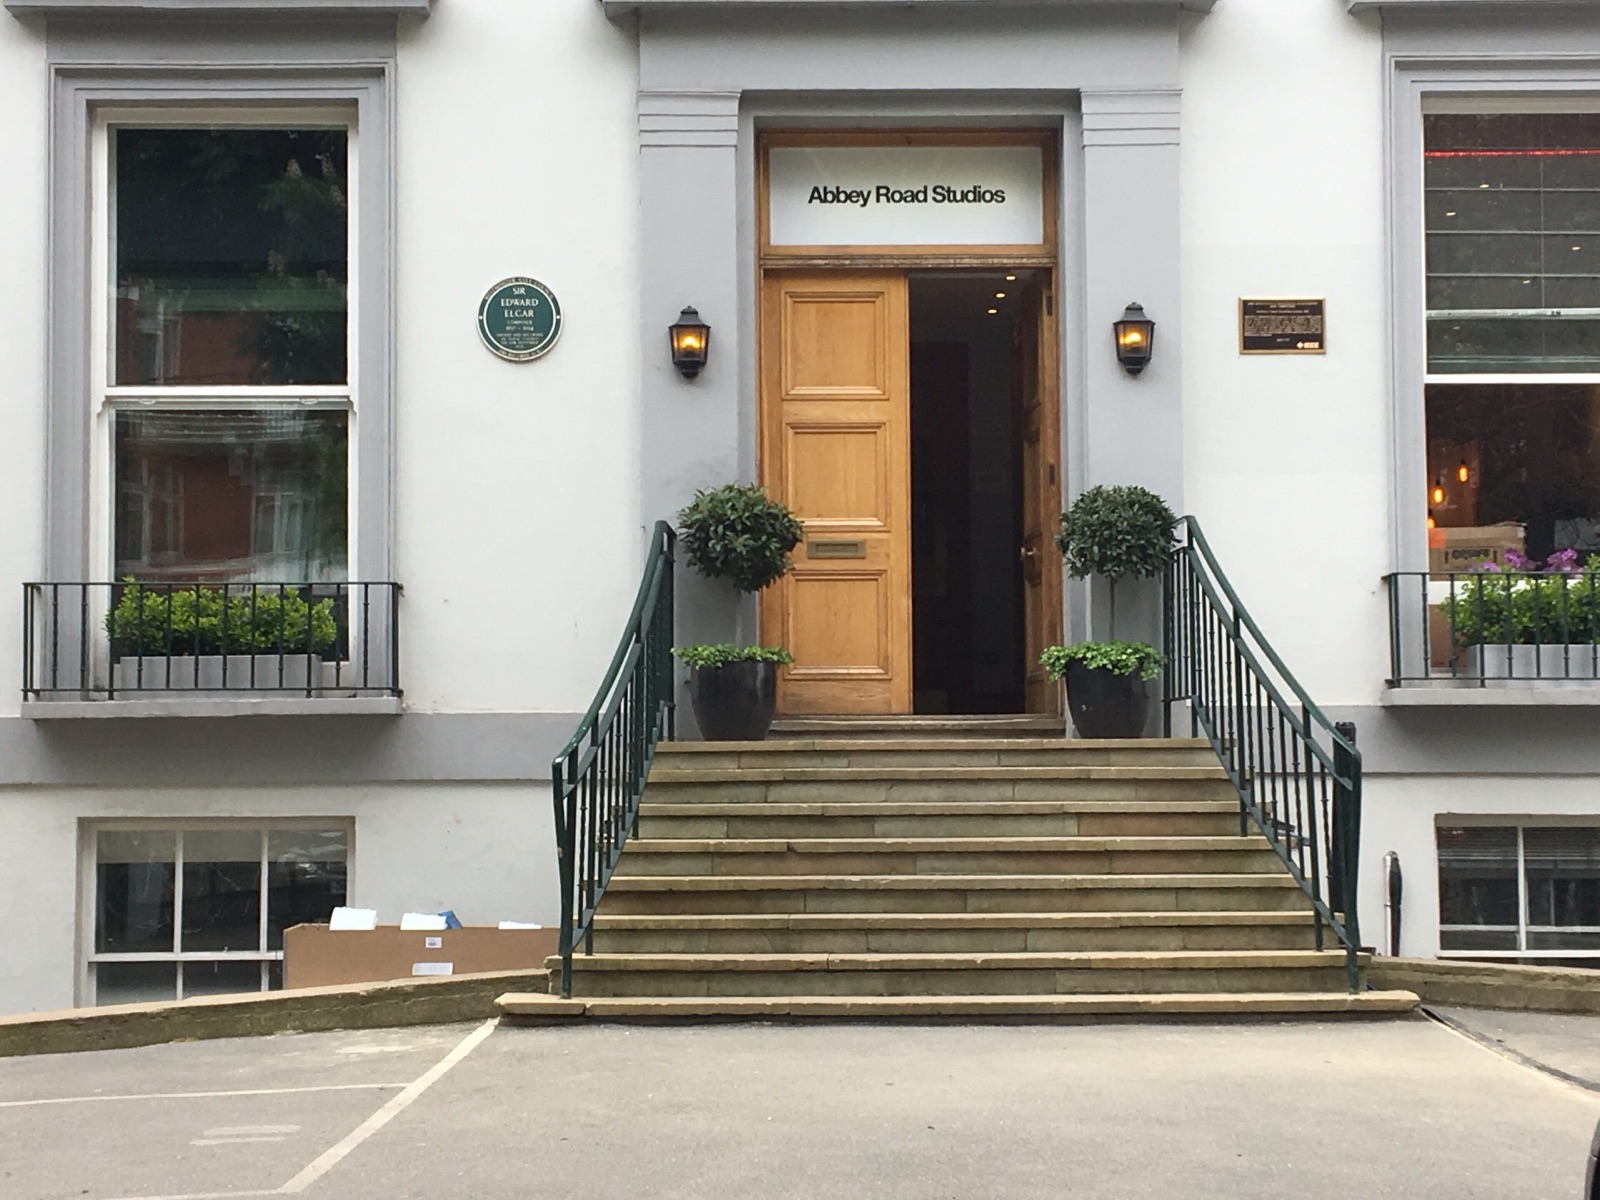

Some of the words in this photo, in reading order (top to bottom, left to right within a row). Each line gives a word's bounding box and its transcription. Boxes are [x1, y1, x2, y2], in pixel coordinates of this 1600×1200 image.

[808, 185, 872, 208] Abbey
[875, 185, 928, 204] Road
[931, 185, 1006, 204] Studios
[512, 287, 526, 295] SIR
[500, 298, 539, 307] EDWARD
[504, 309, 535, 318] ELGAR
